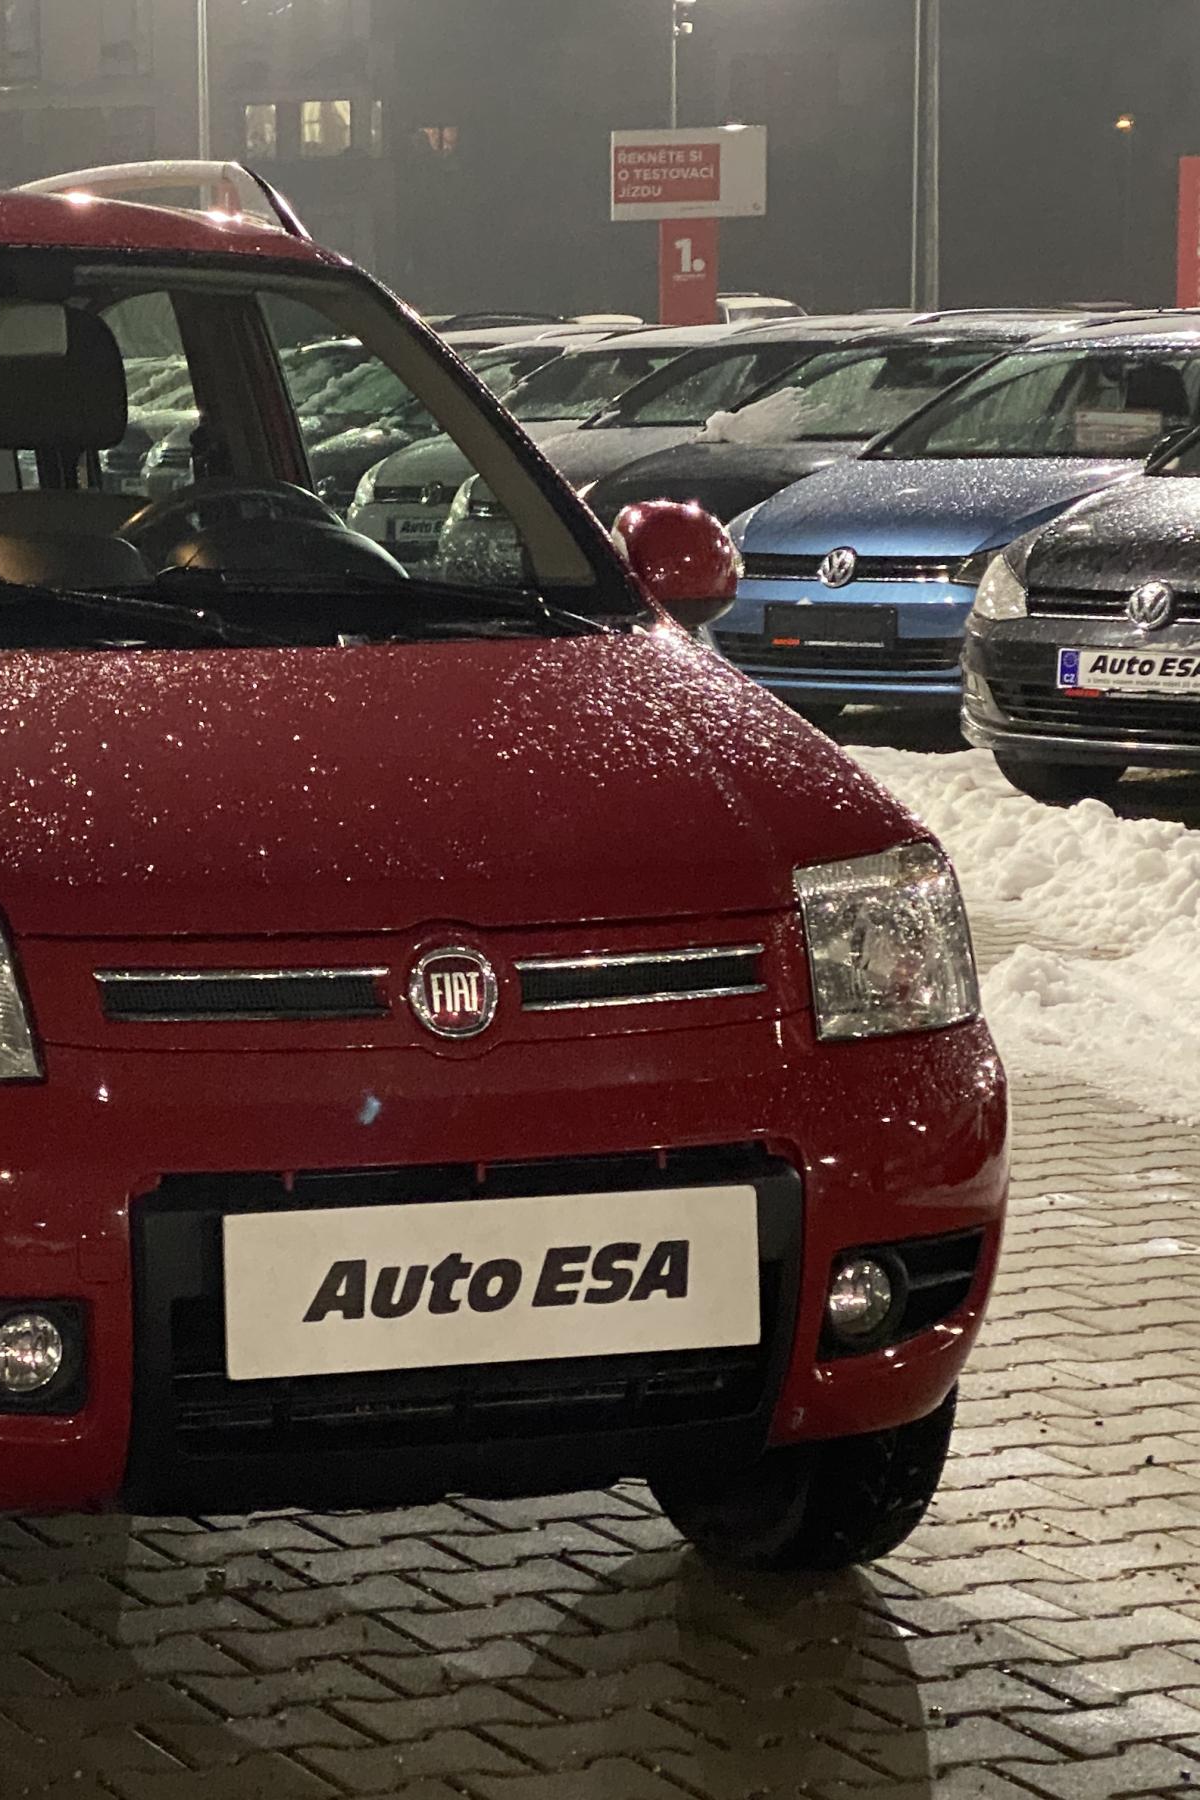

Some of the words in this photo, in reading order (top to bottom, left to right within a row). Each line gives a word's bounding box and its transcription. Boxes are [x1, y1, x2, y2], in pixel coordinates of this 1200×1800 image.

[617, 149, 685, 164] ŘEKNĚTE
[689, 149, 703, 162] SI
[617, 169, 629, 181] O
[633, 165, 714, 180] TESTOVACÍ
[674, 238, 705, 273] 1.
[1089, 655, 1156, 676] Auto
[1063, 673, 1076, 683] CZ
[430, 971, 480, 1013] FIAT
[302, 1253, 522, 1322] Auto
[531, 1240, 689, 1307] ESA
